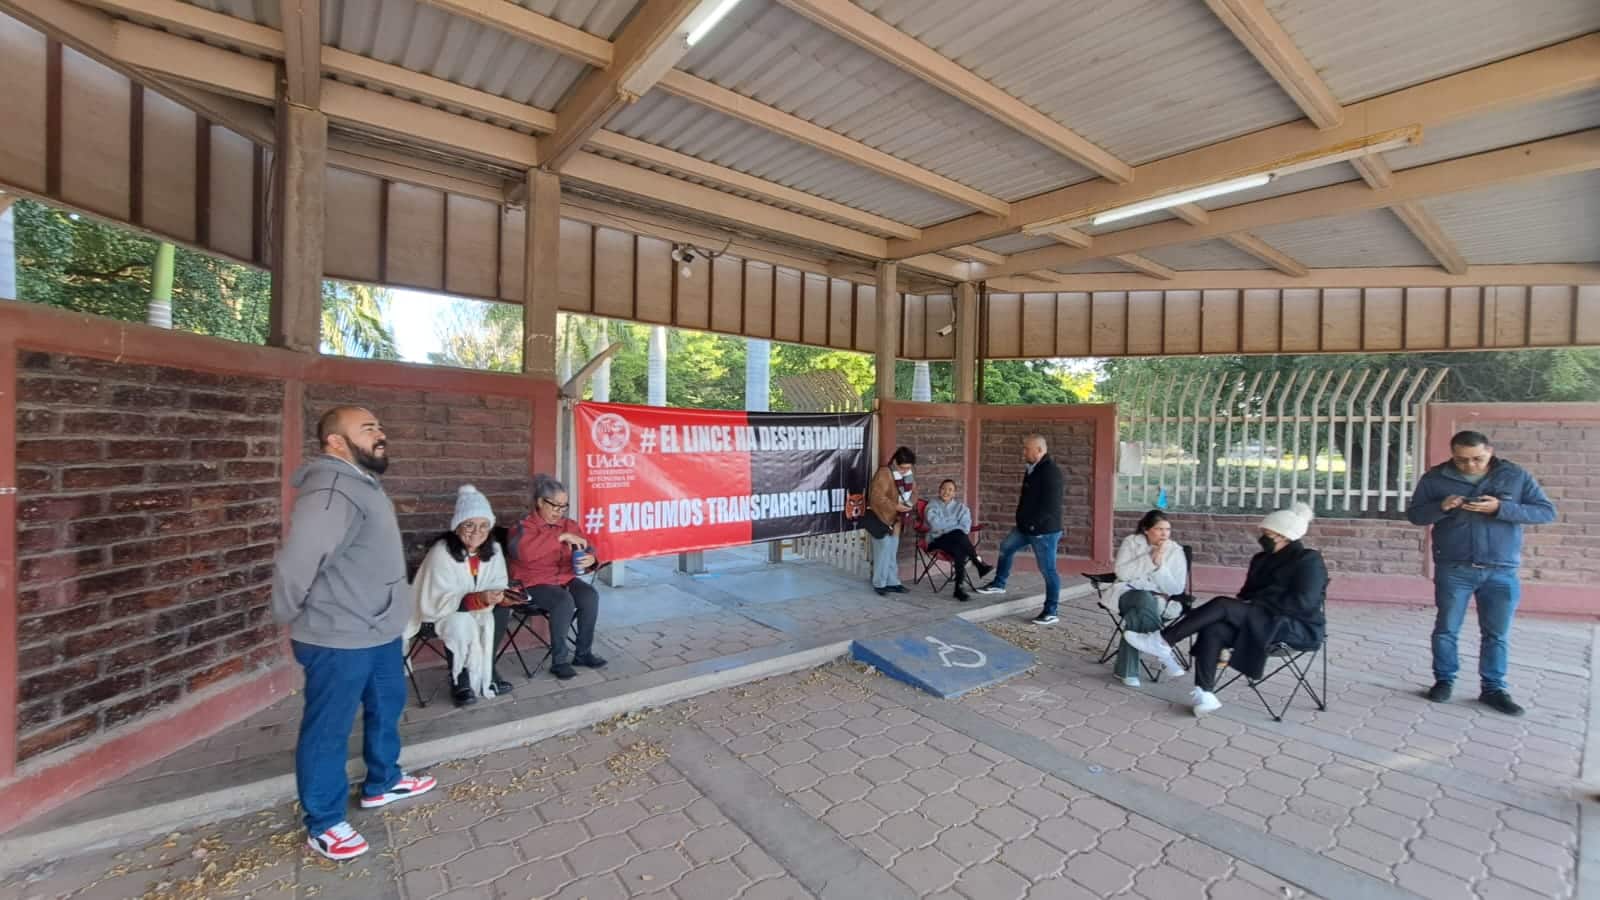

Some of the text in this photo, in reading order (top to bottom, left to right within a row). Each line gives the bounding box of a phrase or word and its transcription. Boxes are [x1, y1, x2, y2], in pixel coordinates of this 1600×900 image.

[640, 427, 656, 453] #
[660, 425, 680, 453] EL
[682, 425, 731, 453] LINCE
[734, 425, 757, 451] HA
[585, 488, 845, 534] # EXIGIMOS TRANSPARENCIA !!!
